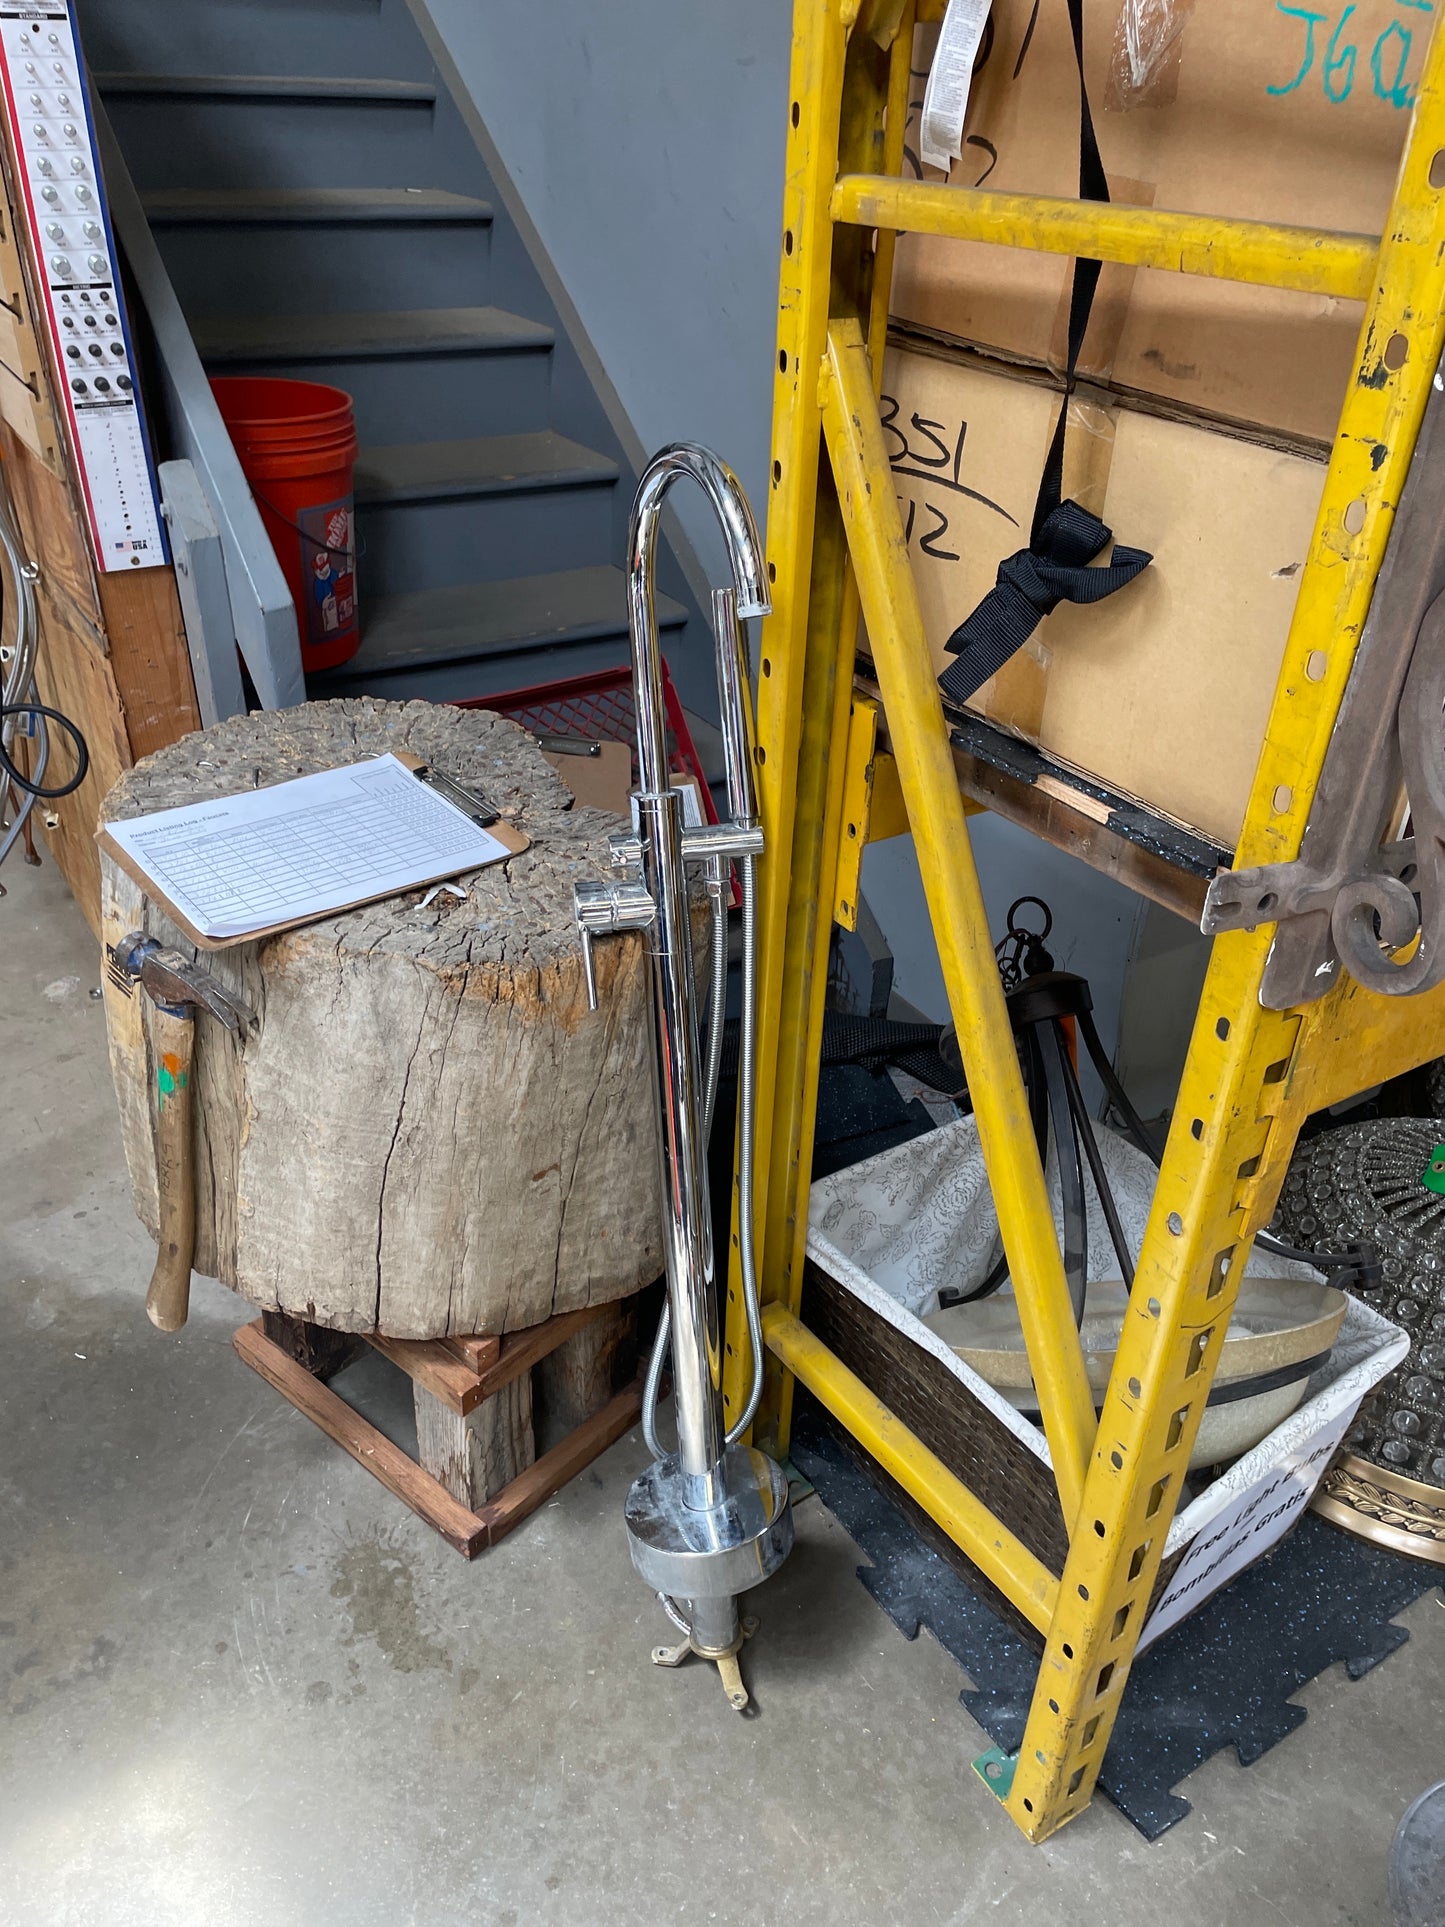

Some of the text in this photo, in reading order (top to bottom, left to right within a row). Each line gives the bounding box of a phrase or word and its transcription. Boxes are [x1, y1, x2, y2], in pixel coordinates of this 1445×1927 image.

[129, 829, 159, 840] Product
[1158, 1485, 1310, 1614] Bombillas Gratis
[1184, 1440, 1336, 1566] Free Light Bulbs
